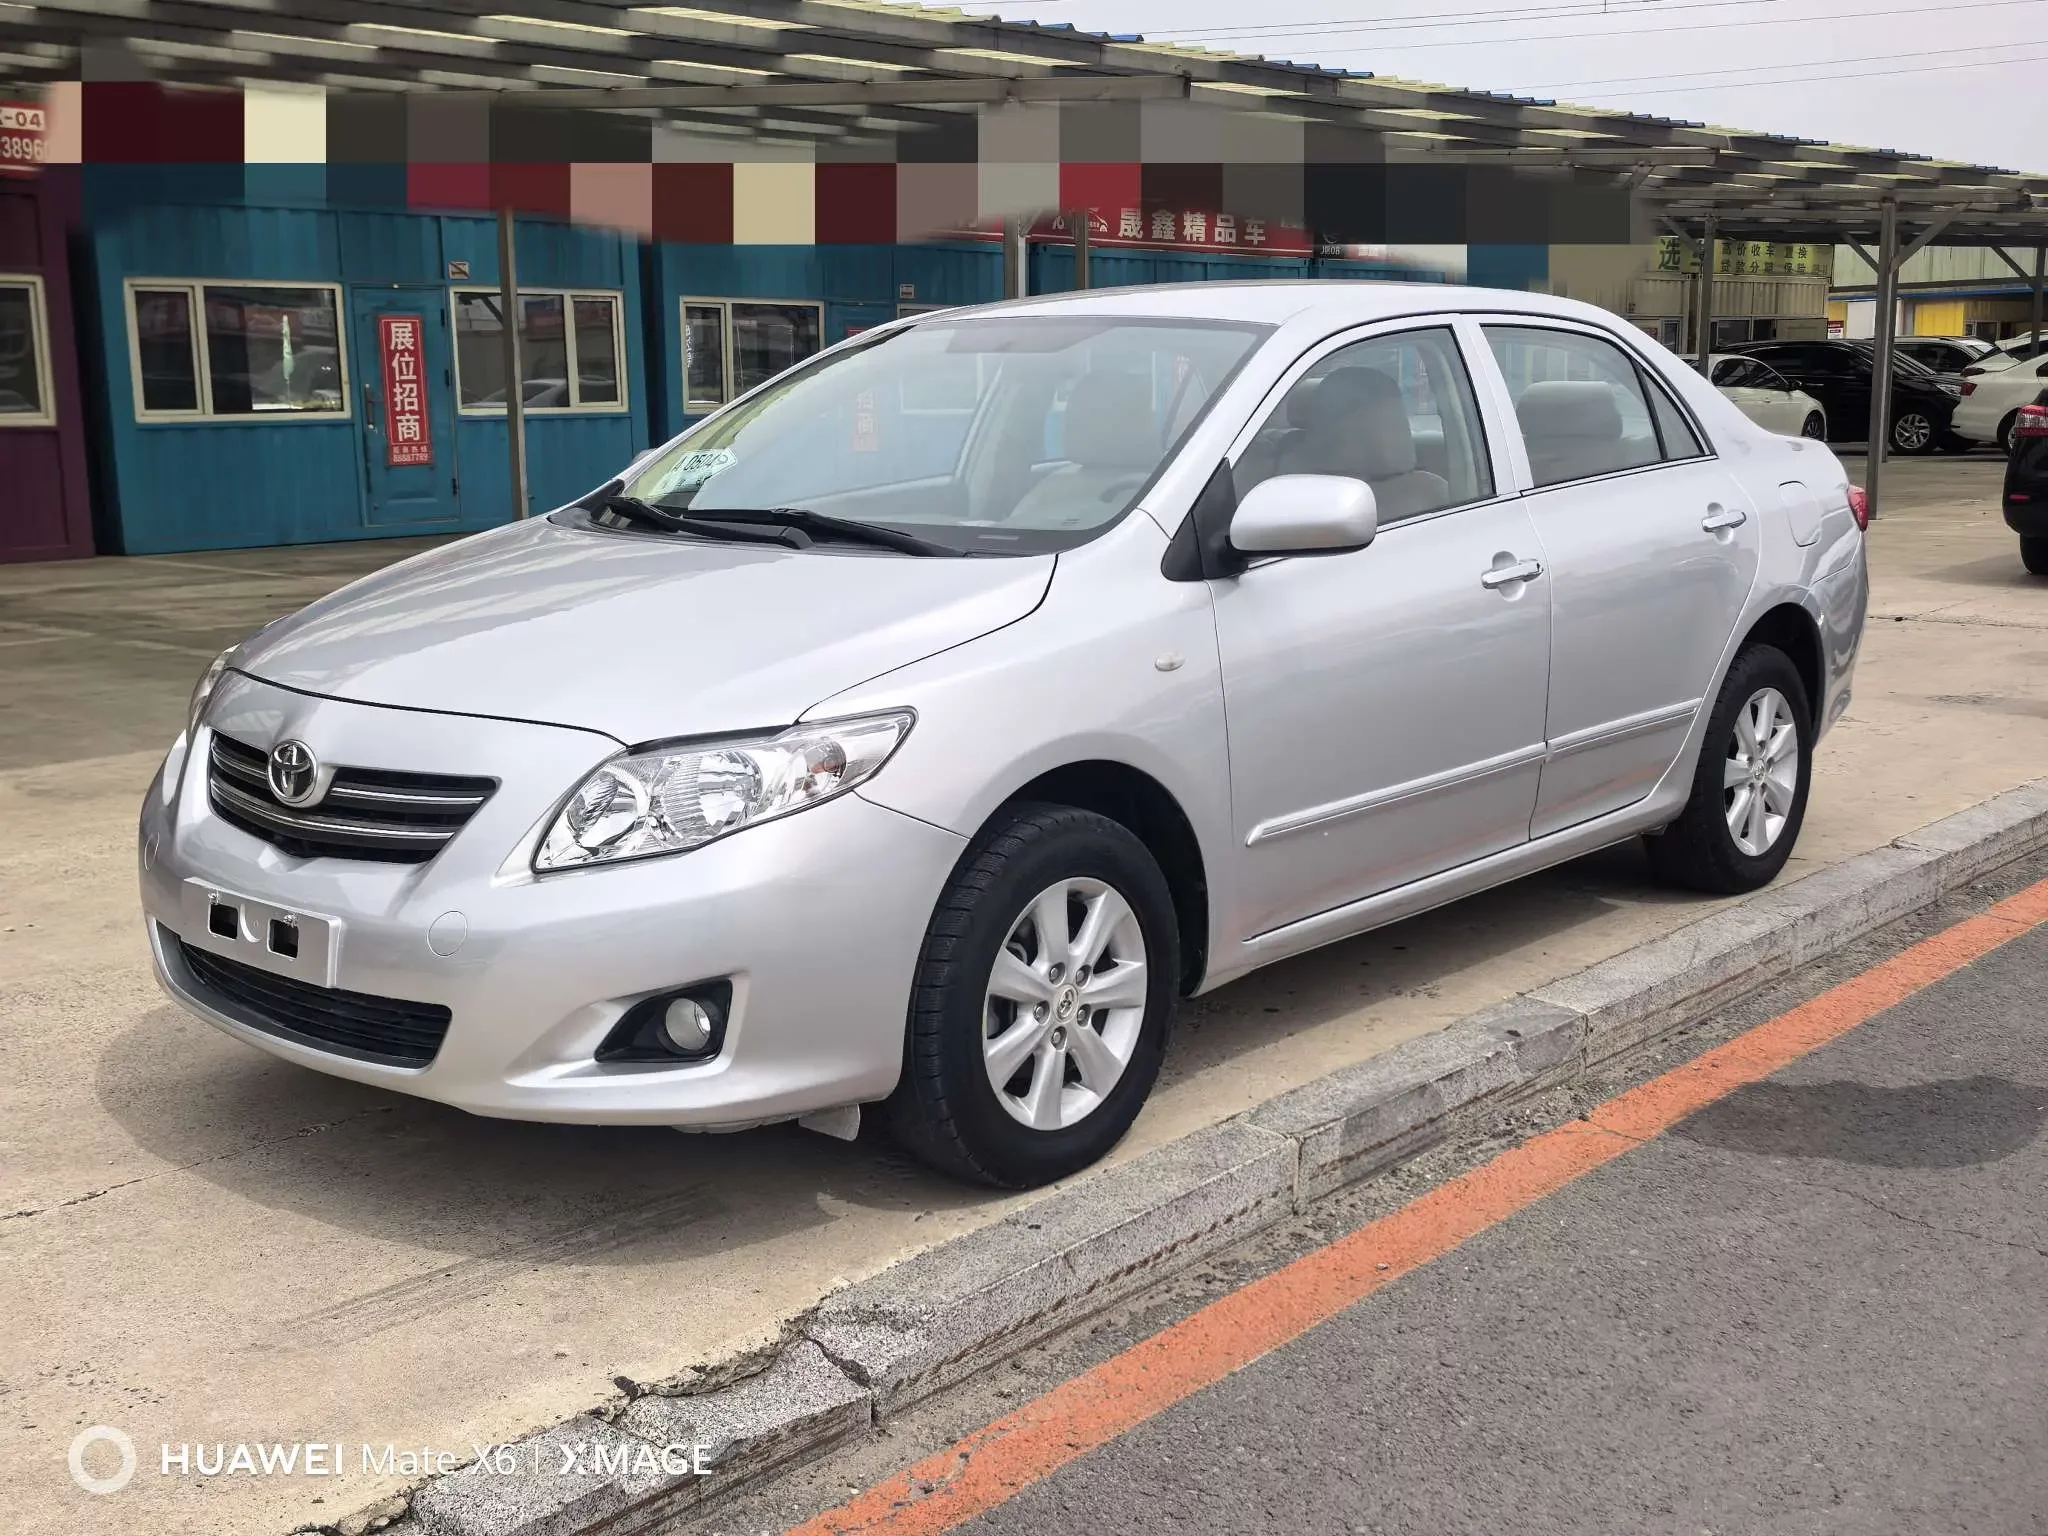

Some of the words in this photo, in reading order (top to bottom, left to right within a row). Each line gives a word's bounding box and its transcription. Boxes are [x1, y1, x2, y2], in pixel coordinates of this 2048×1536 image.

[0, 109, 41, 128] -04
[390, 322, 420, 441] 展位招商
